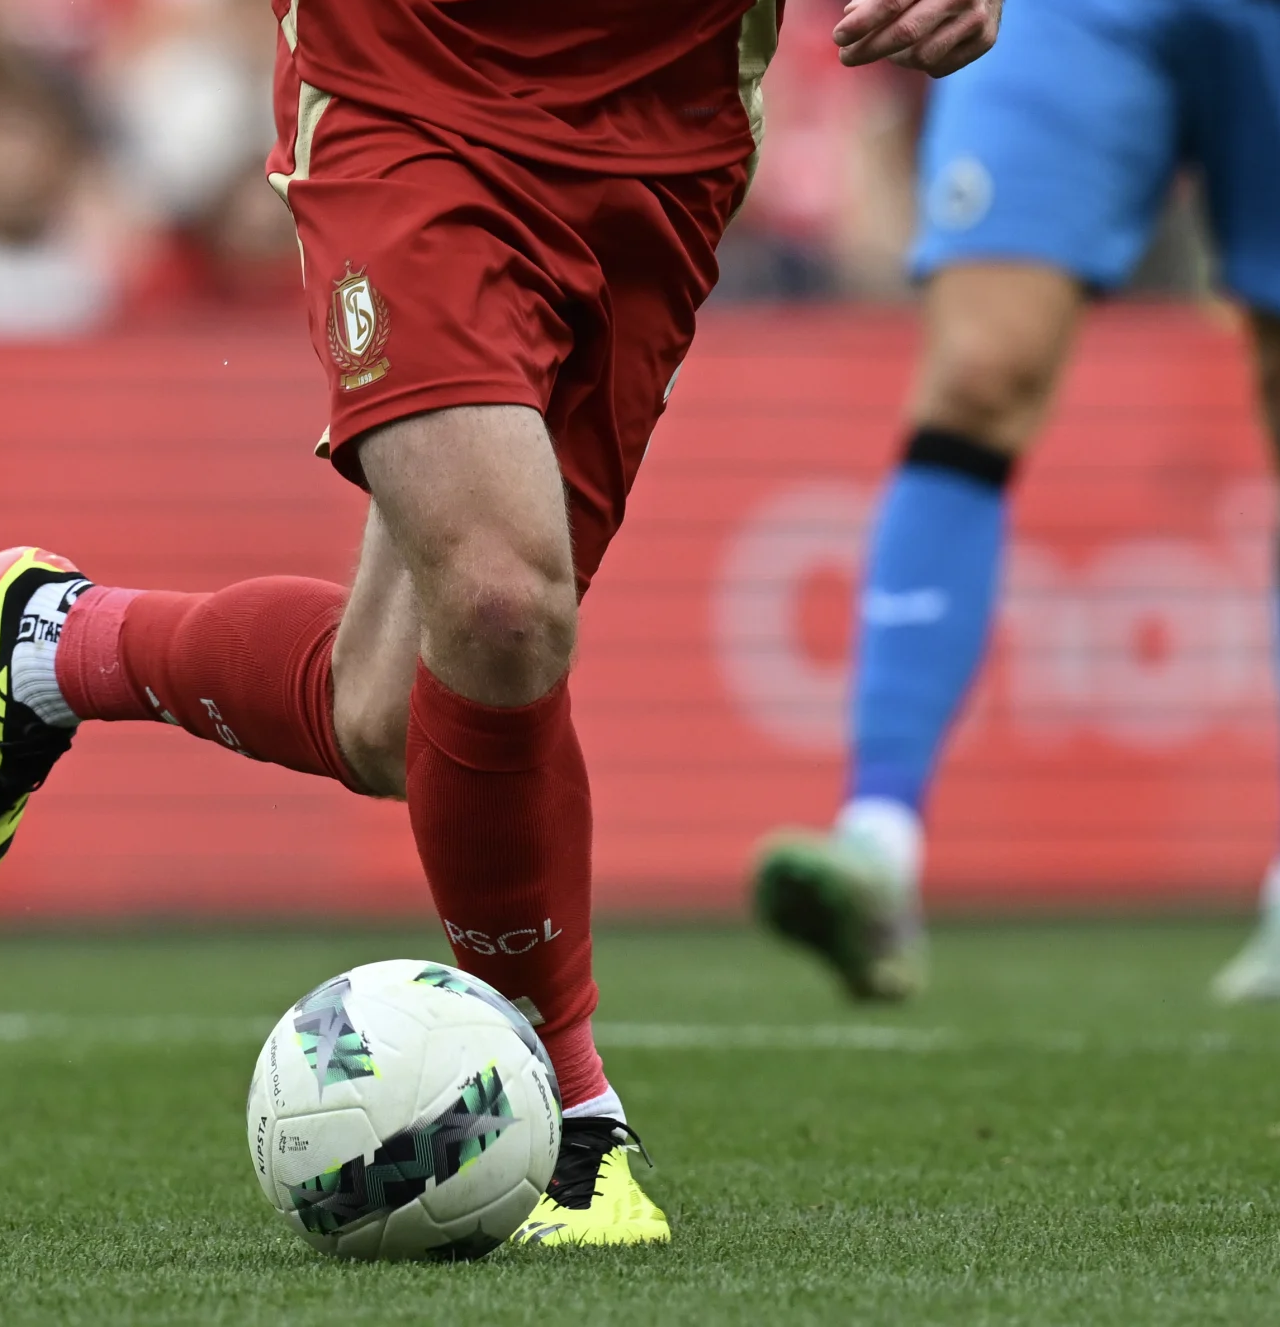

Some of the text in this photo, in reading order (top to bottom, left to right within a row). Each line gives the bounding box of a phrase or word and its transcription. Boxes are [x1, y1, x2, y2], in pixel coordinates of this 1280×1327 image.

[357, 372, 373, 386] 1898
[444, 918, 563, 956] RSCL
[273, 1074, 282, 1097] Pro
[531, 1070, 552, 1120] League
[257, 1116, 268, 1175] KIPSTA
